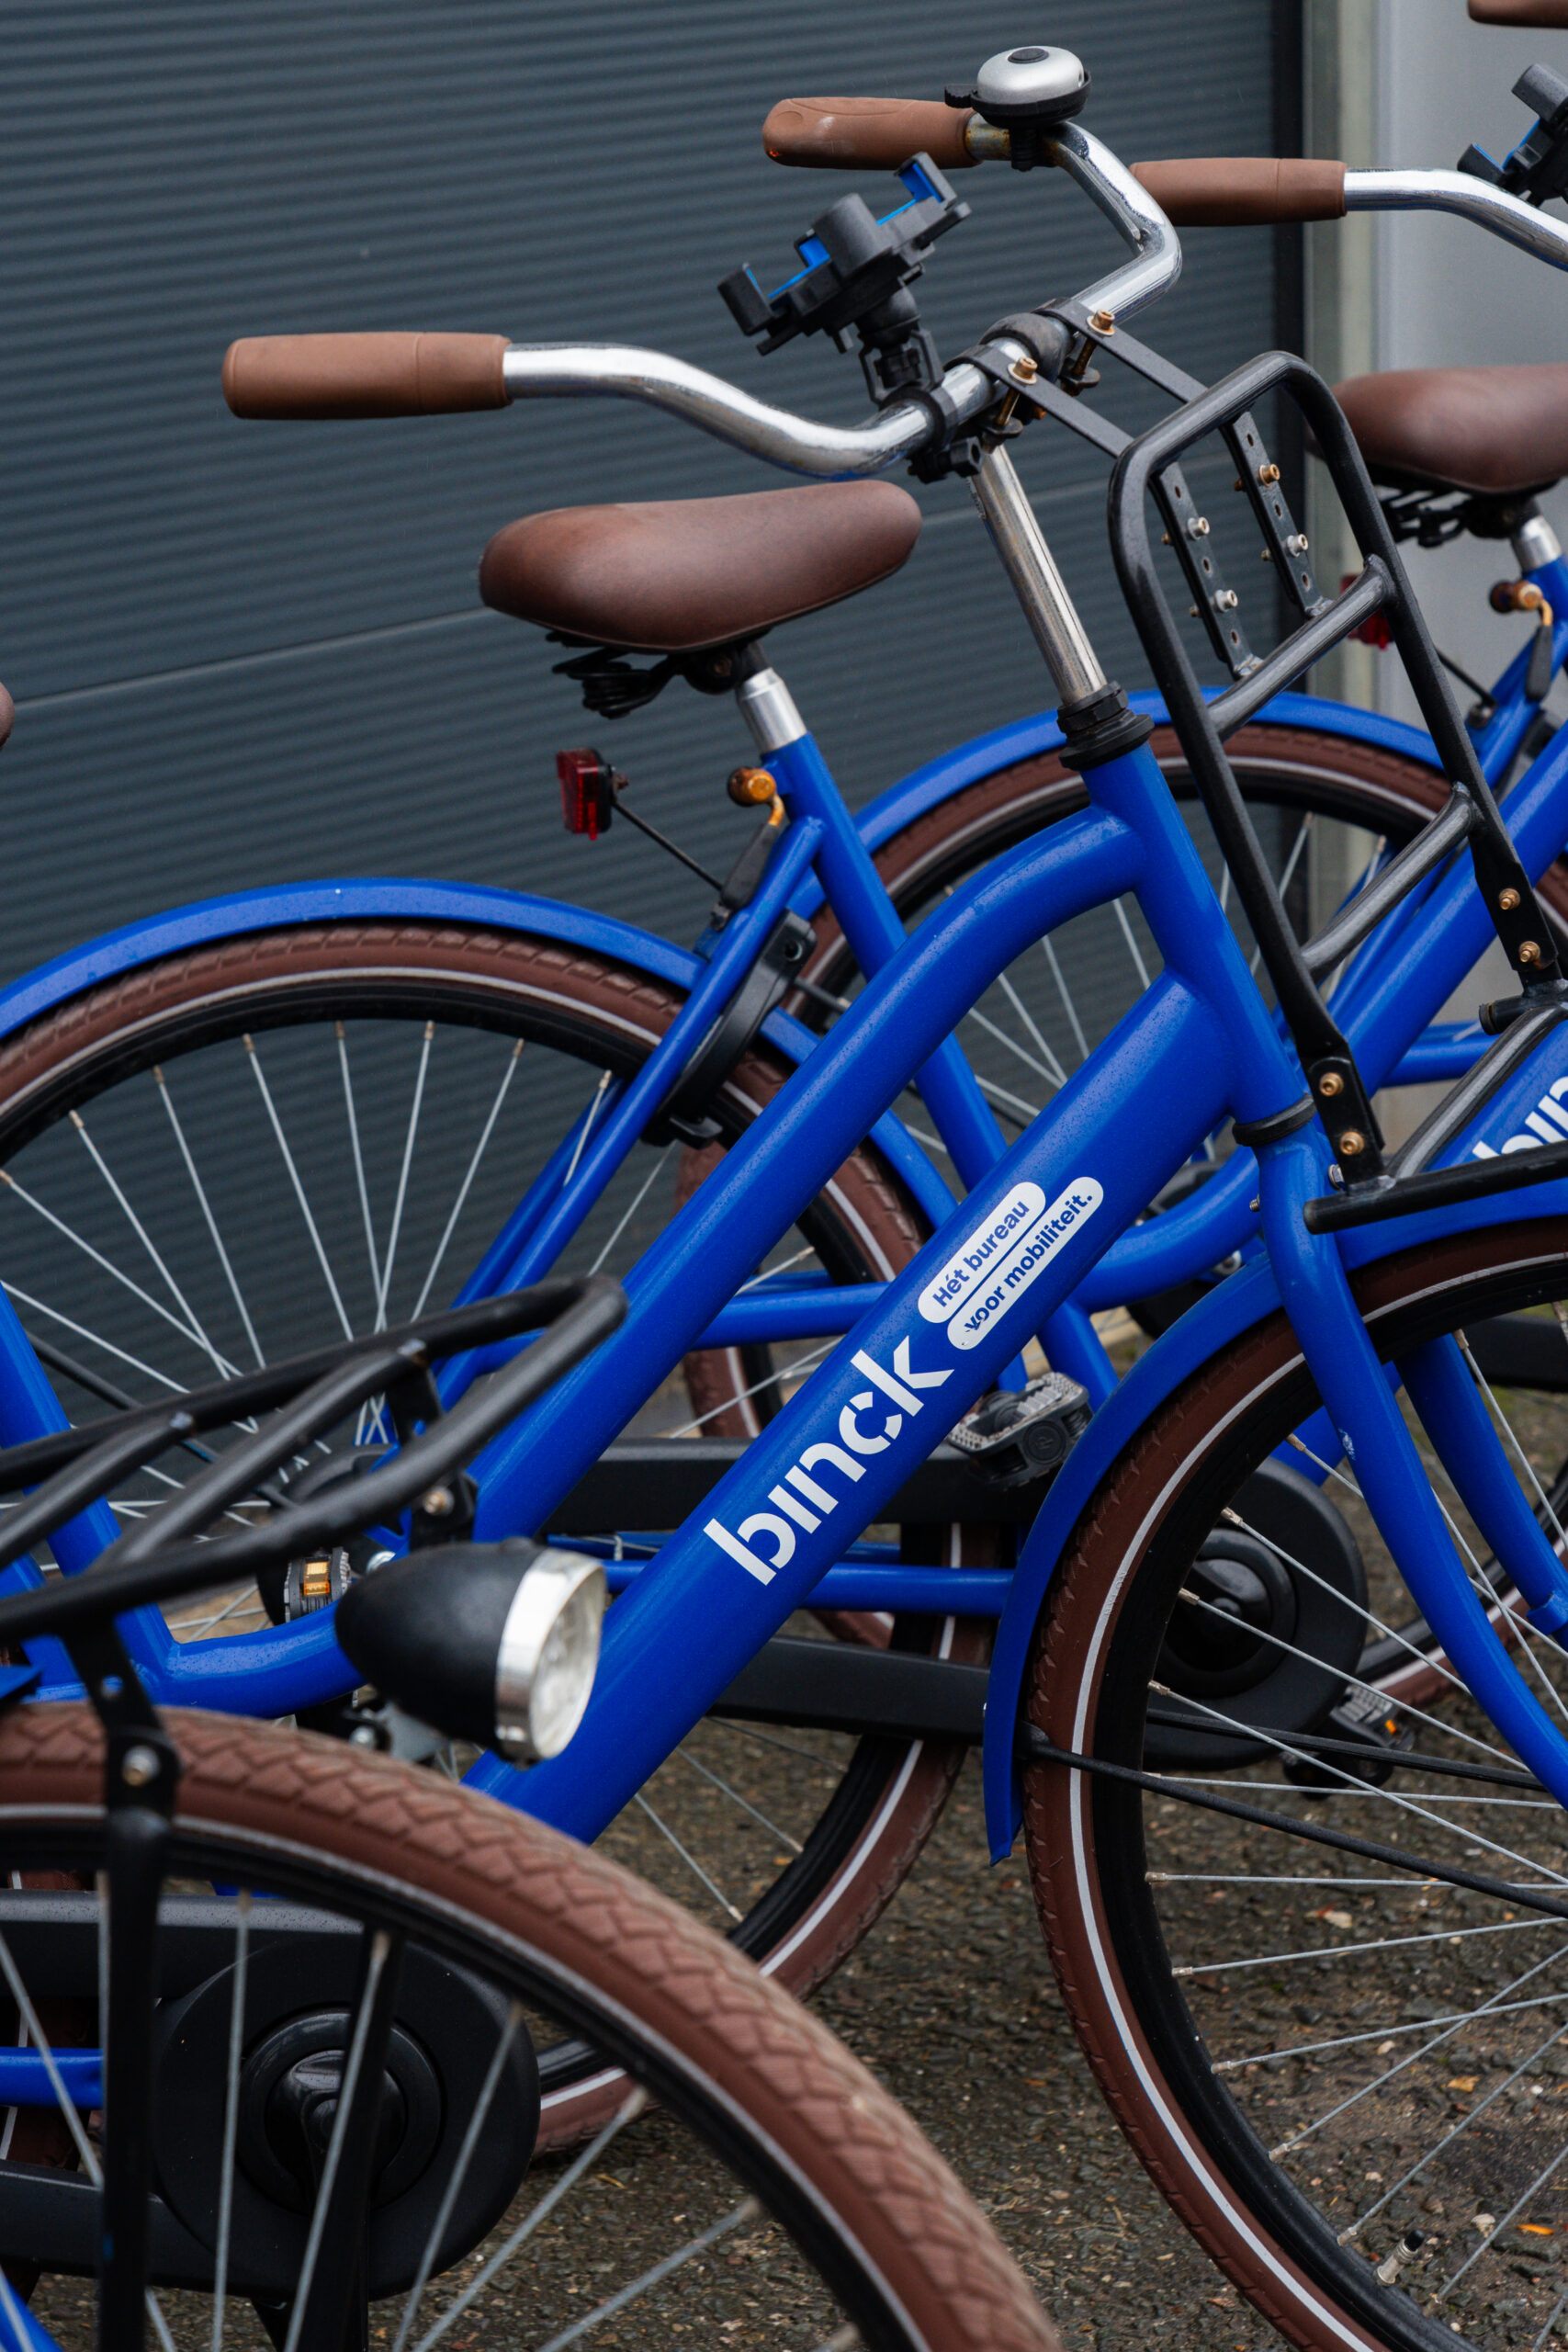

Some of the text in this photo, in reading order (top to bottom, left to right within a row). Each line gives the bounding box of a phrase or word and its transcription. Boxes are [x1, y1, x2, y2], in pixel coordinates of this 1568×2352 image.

[932, 1201, 1030, 1307] Hét bureau
[964, 1195, 1093, 1332] voor mobiliteit.
[703, 1335, 955, 1587] binck
